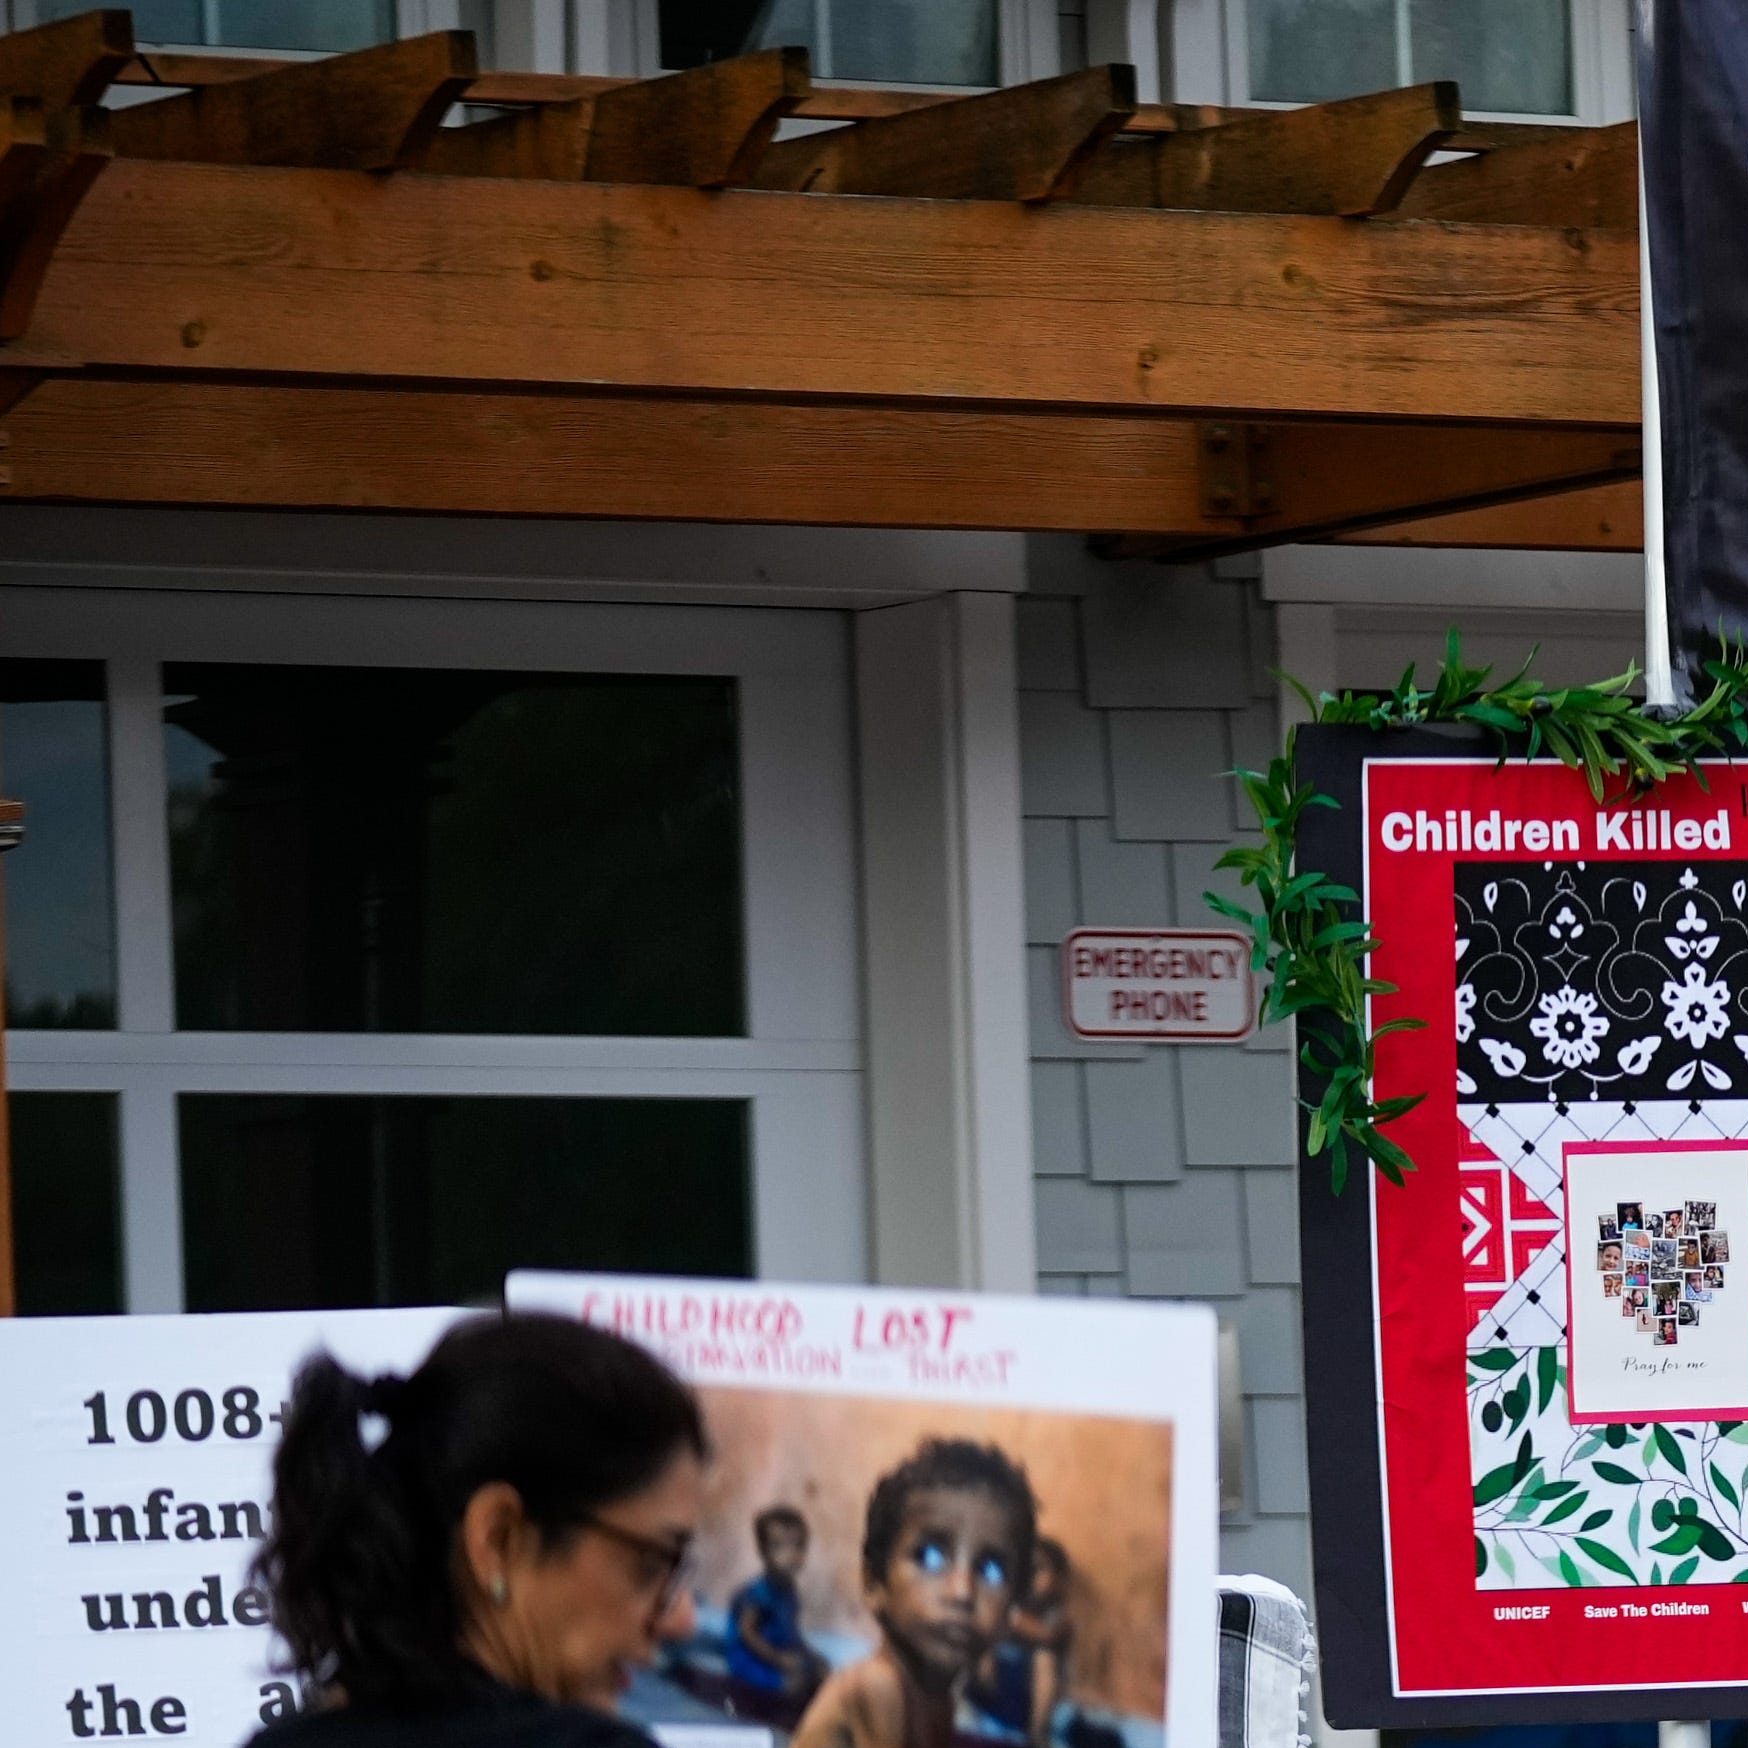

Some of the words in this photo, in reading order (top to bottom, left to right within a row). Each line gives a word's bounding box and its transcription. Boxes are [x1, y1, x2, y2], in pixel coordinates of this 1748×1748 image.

[1381, 810, 1580, 851] Children
[1596, 809, 1731, 851] Killed
[1075, 948, 1242, 978] EMERGENCY
[1111, 990, 1208, 1021] PHONE
[853, 1303, 973, 1353] LOST
[66, 1488, 275, 1544] infan
[81, 1574, 271, 1631] unde
[1494, 1606, 1550, 1621] UNICEF
[1584, 1605, 1617, 1619] Save
[1621, 1603, 1648, 1618] The
[1651, 1602, 1709, 1617] Children
[66, 1683, 187, 1737] the
